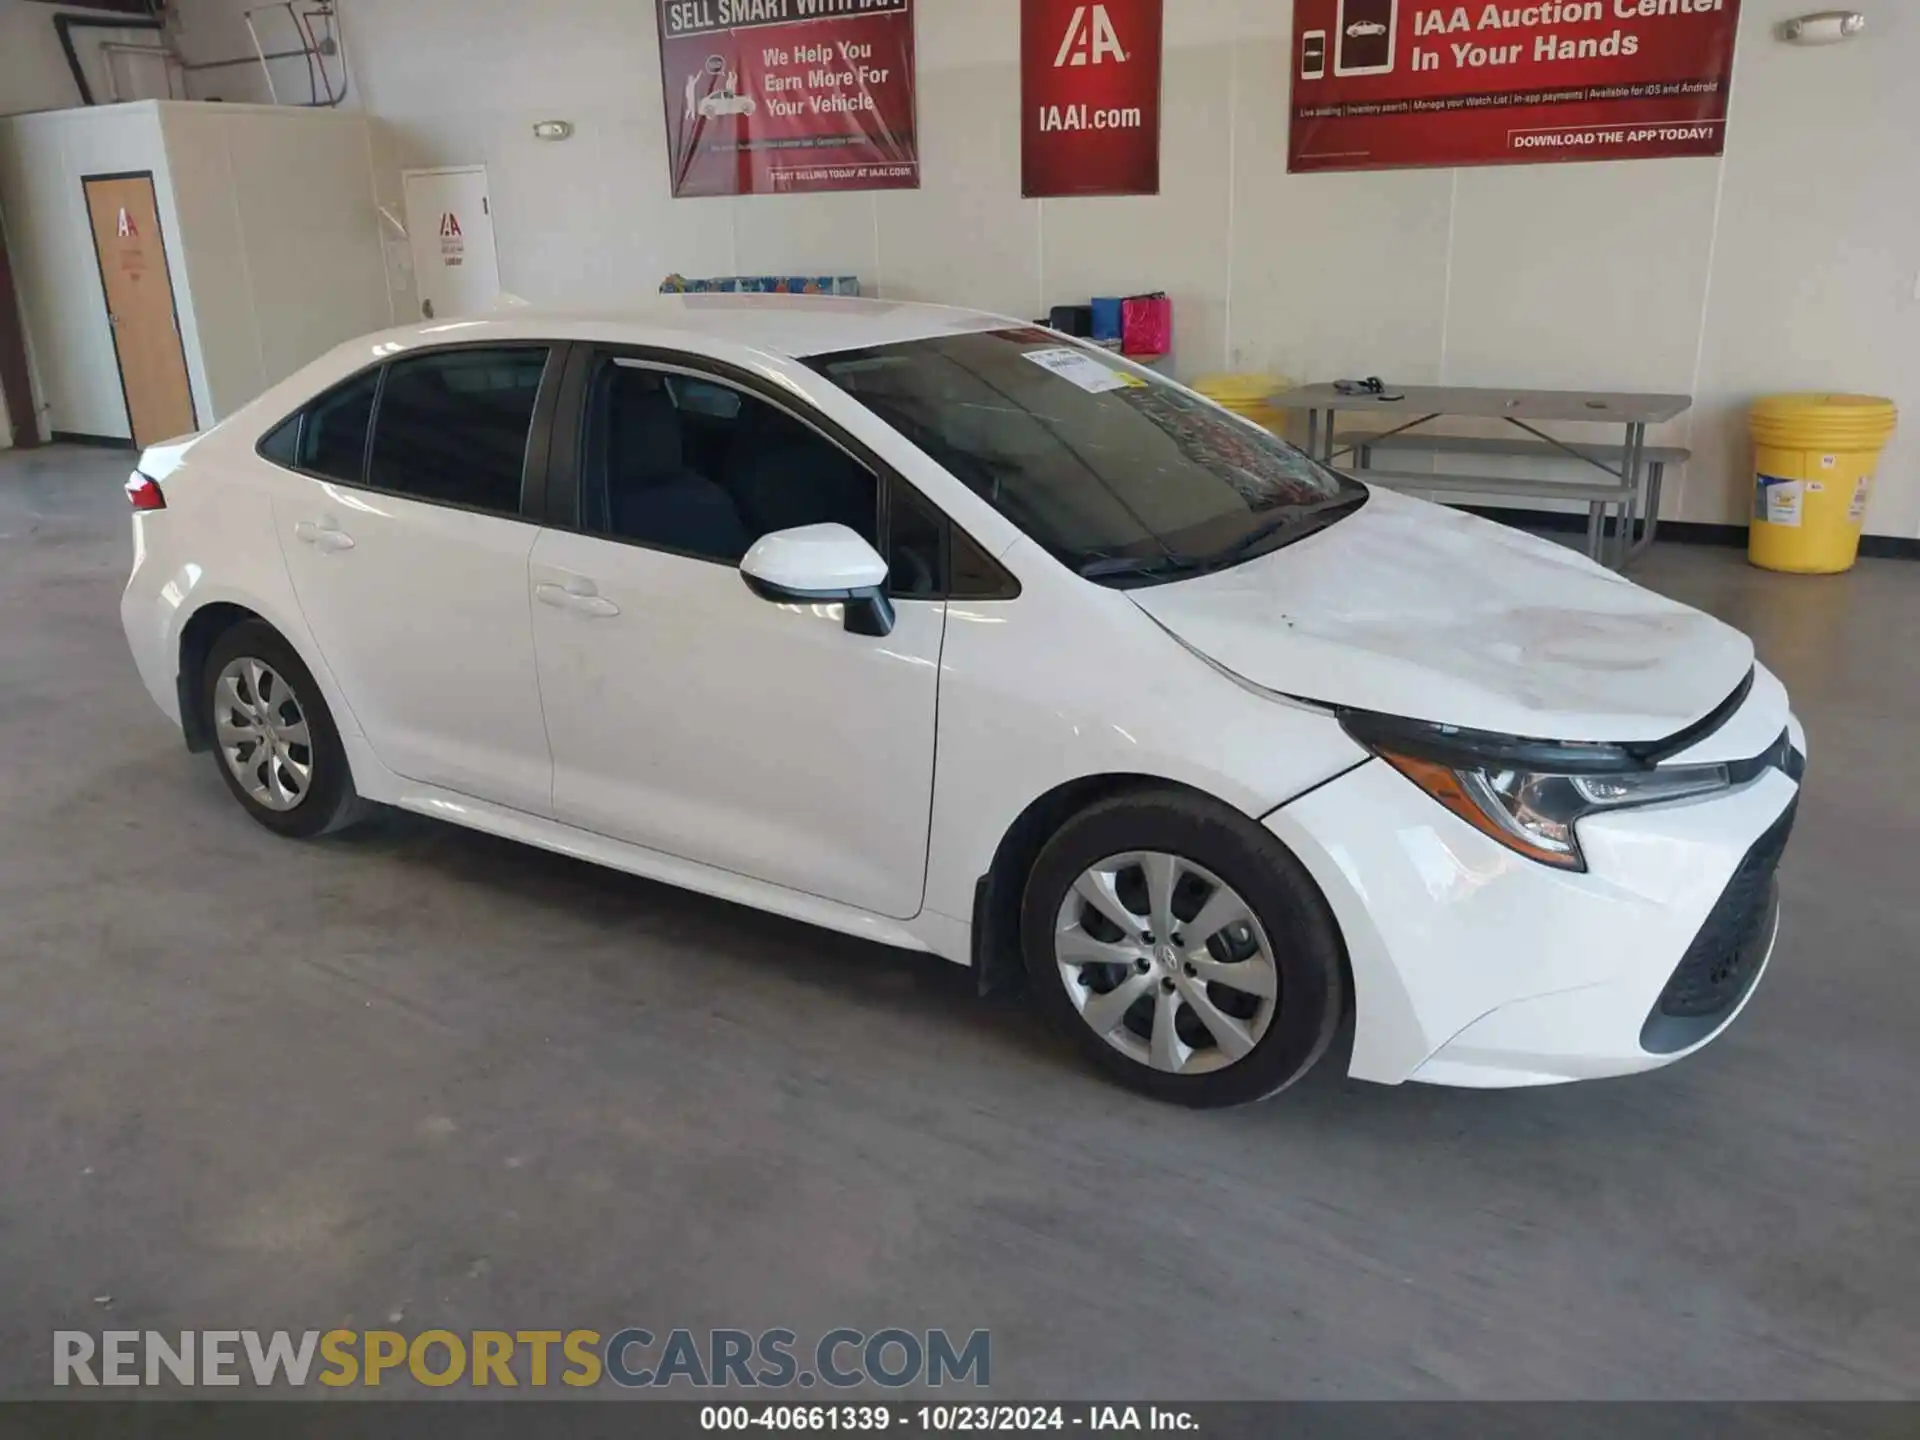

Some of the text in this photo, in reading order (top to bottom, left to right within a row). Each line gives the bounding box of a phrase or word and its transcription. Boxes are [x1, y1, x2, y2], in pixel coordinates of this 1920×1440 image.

[671, 0, 714, 31] SELL
[718, 0, 788, 24] SMART
[1414, 0, 1724, 37] IAA Auction Center
[763, 40, 873, 67] We Help You
[1411, 30, 1639, 71] In Your Hands
[764, 65, 890, 92] Earn More For
[1590, 87, 1630, 99] Available
[1630, 86, 1644, 97] for
[1663, 83, 1680, 95] and
[1681, 80, 1719, 93] Android
[766, 91, 875, 117] Your Vehicle
[1040, 104, 1141, 132] IAAI.com
[1514, 127, 1713, 148] DOWNLOAD THE APP TODAY!
[828, 168, 855, 179] TODAY
[857, 167, 868, 178] AT
